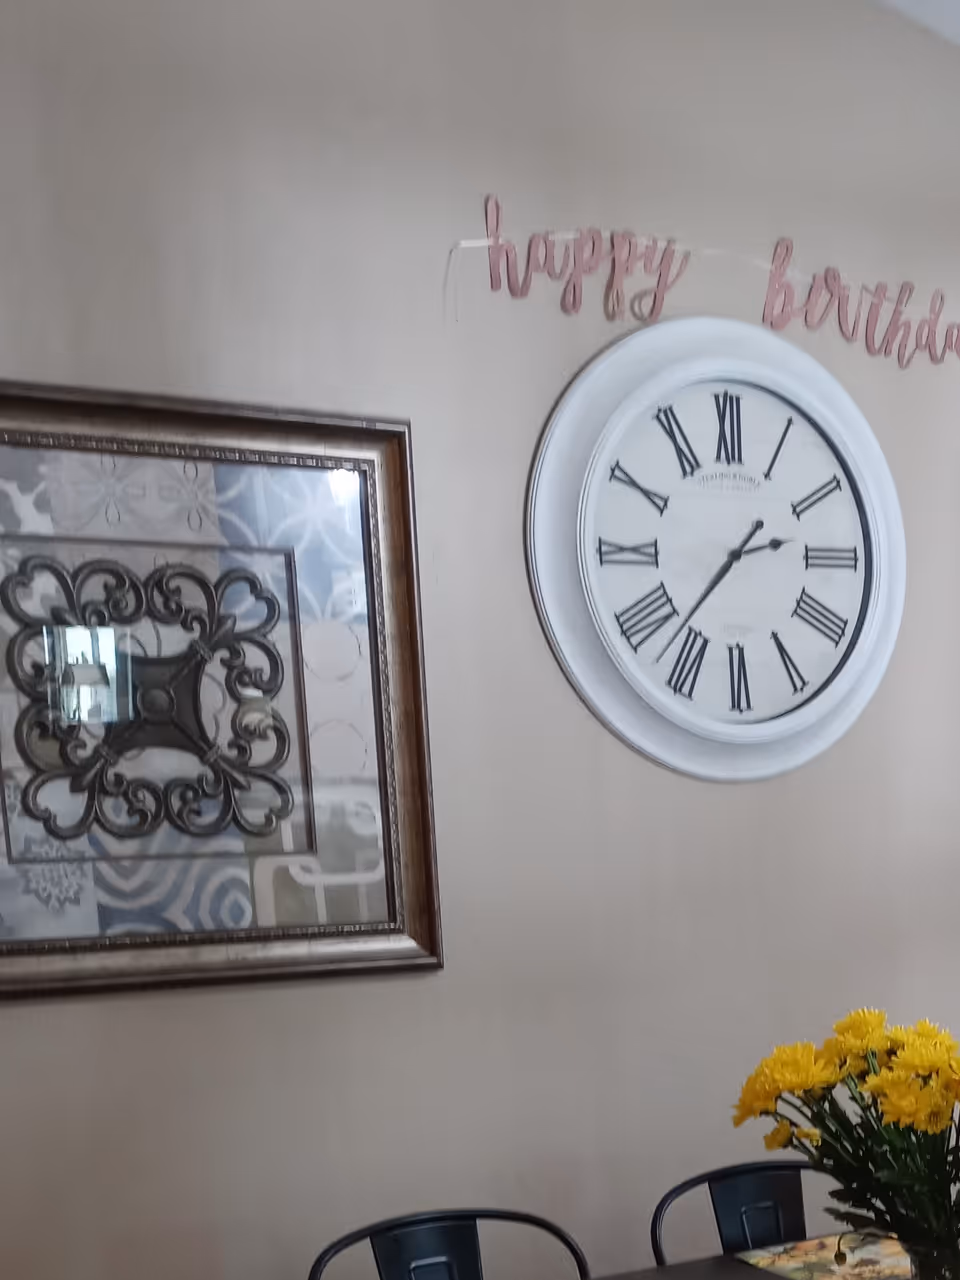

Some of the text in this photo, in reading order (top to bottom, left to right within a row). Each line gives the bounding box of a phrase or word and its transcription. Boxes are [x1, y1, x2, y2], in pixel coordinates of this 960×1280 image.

[483, 193, 692, 324] happy
[653, 404, 702, 480] XI
[713, 389, 743, 465] XII
[609, 459, 670, 517] X
[792, 474, 842, 521] II
[804, 544, 859, 573] III
[666, 625, 711, 700] VII
[727, 642, 754, 713] VI
[770, 630, 809, 696] V
